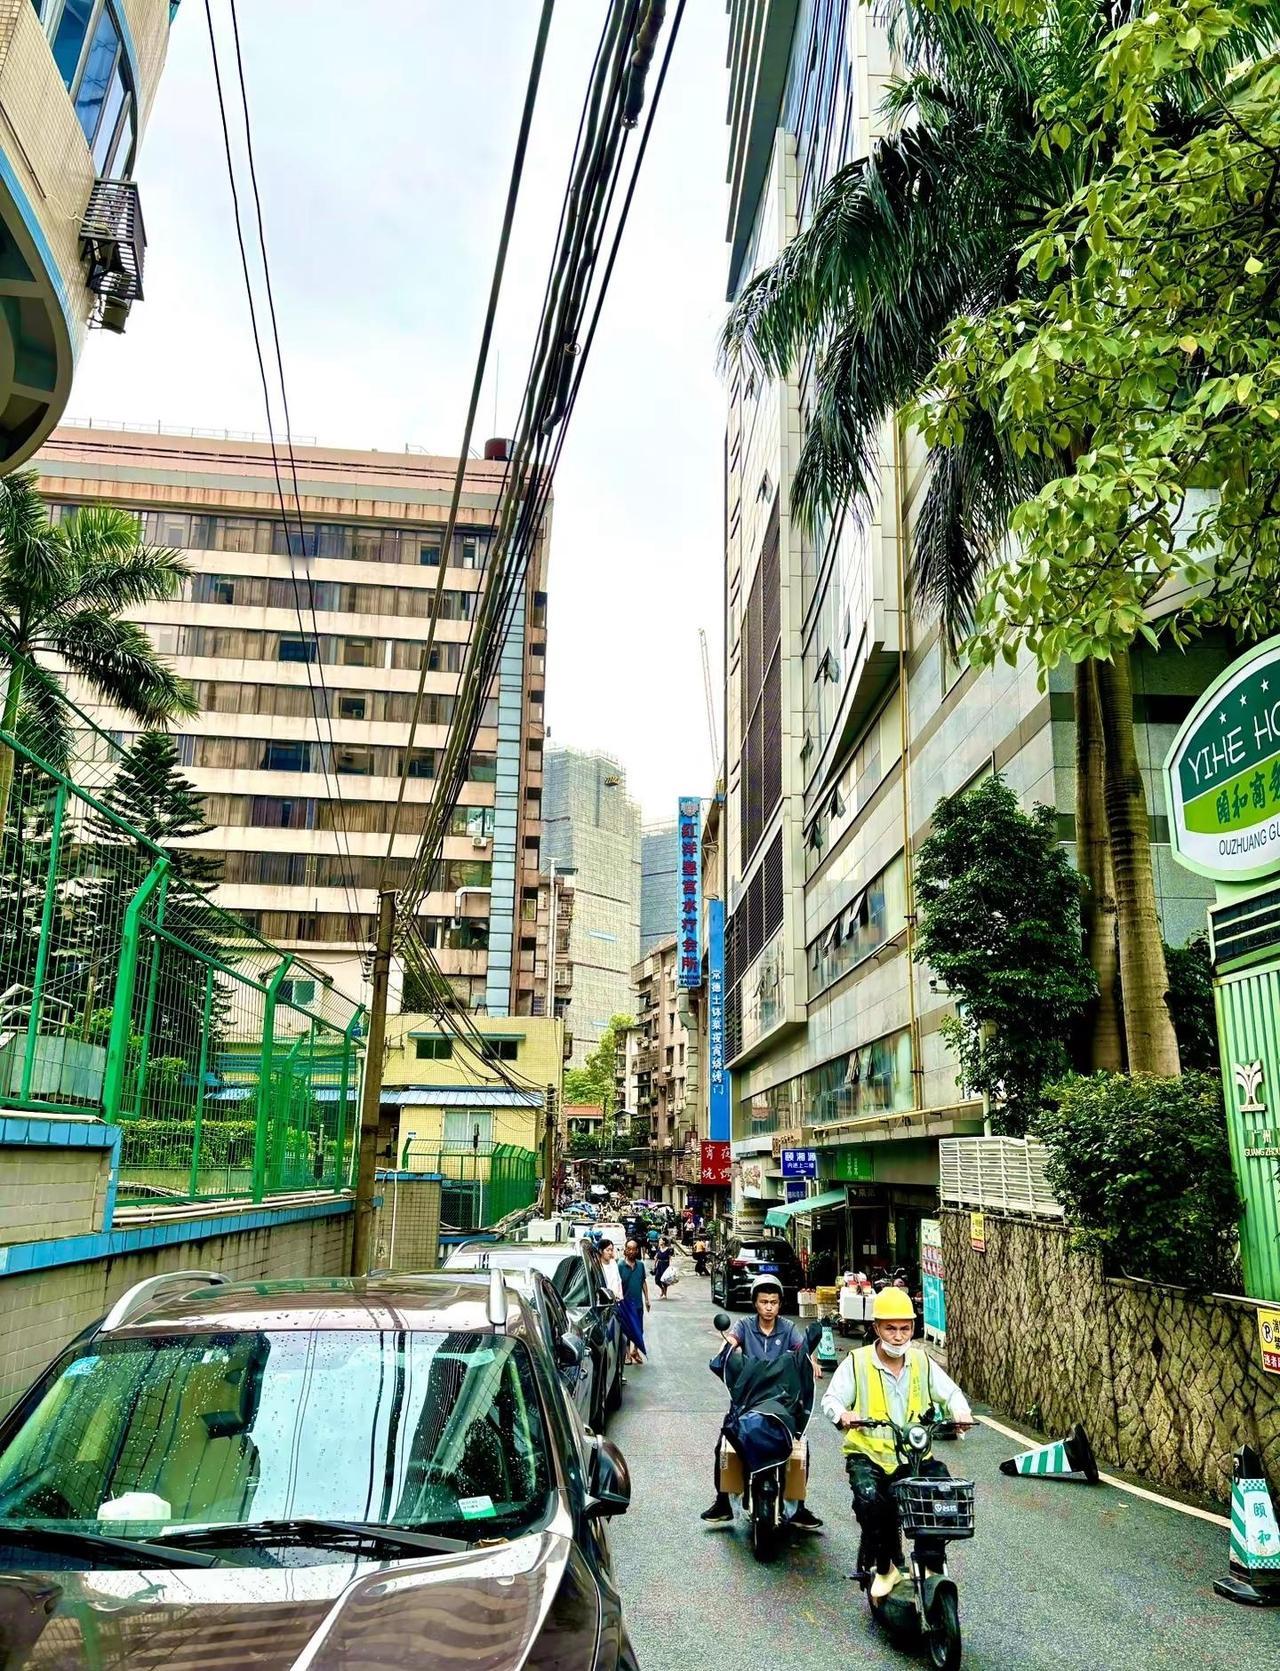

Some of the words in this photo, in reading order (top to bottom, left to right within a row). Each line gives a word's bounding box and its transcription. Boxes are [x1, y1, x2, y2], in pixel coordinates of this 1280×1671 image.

[1188, 726, 1246, 785] YIHE
[1219, 829, 1266, 855] OUZHUANG
[1249, 1129, 1272, 1147] 广州
[1253, 1502, 1271, 1545] 颐和
